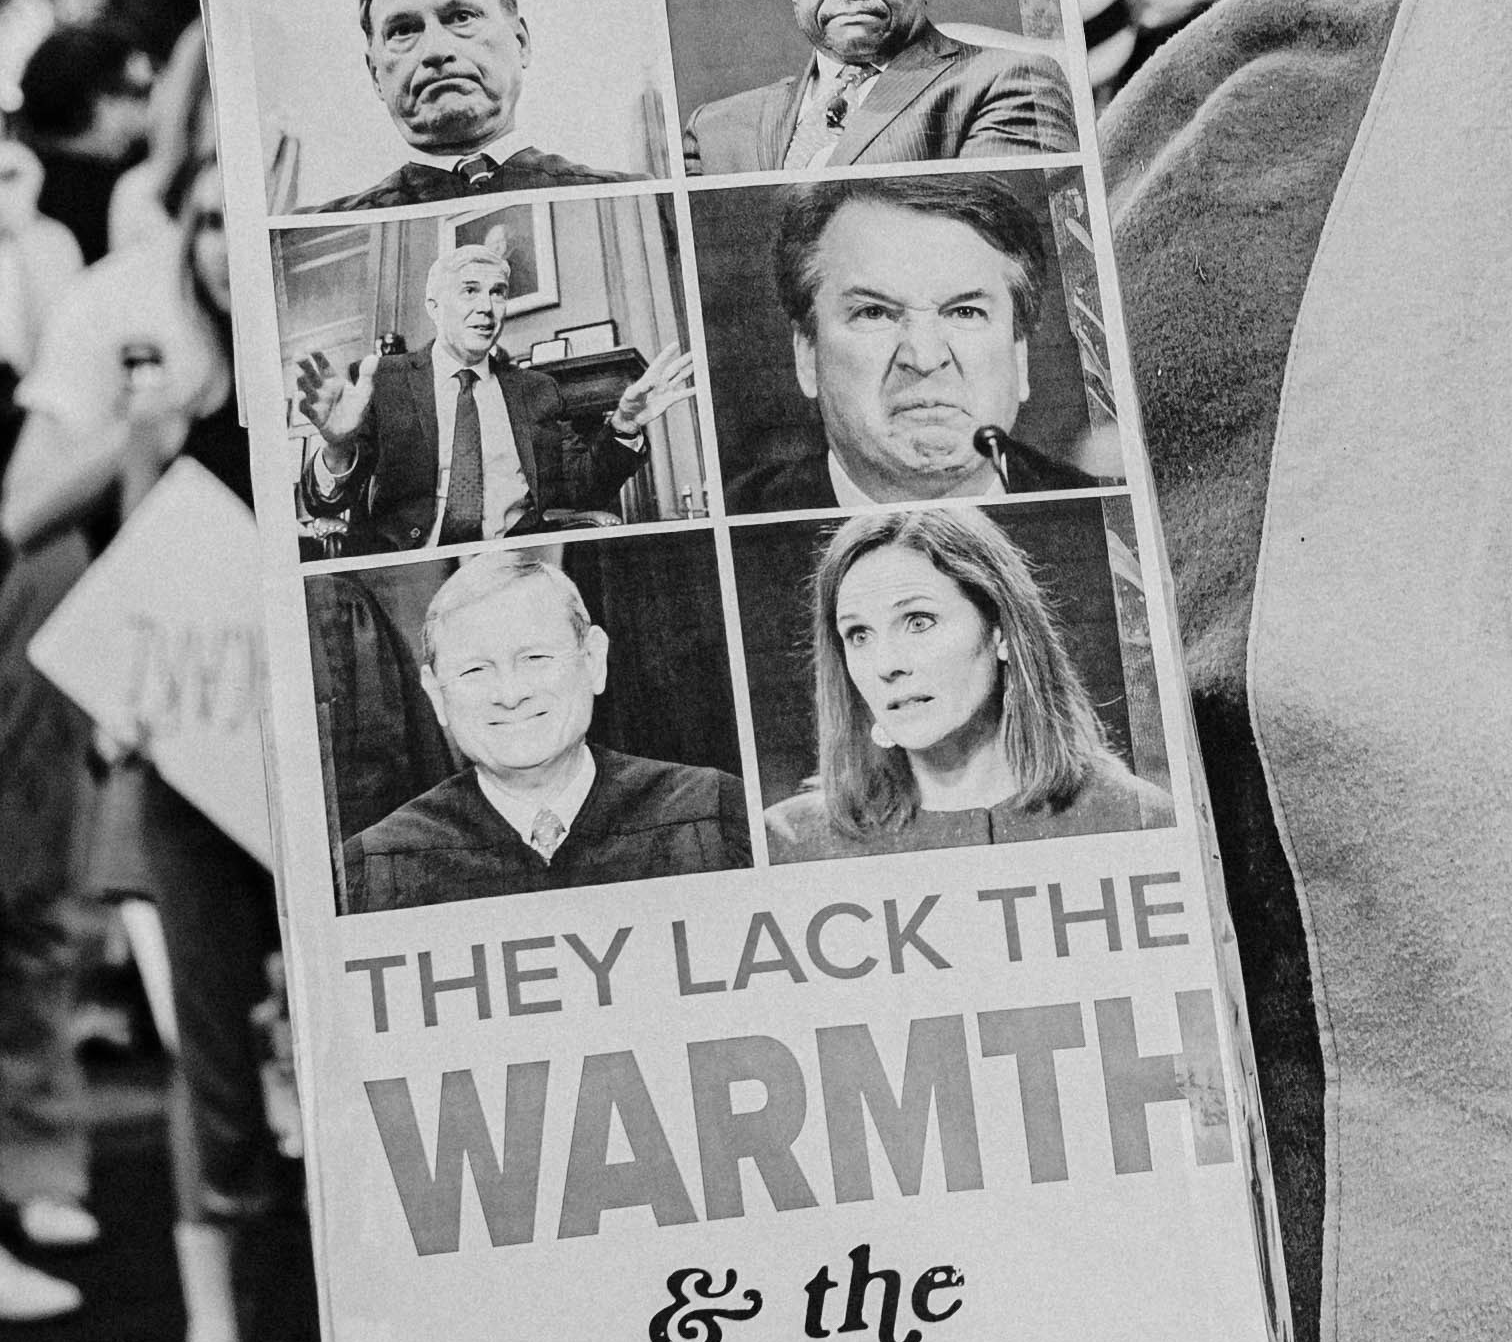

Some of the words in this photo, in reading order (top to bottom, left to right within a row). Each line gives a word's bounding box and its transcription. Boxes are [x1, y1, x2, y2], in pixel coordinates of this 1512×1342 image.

[345, 926, 632, 1033] THEY
[671, 895, 953, 997] LACK
[977, 871, 1190, 966] THE
[363, 987, 1234, 1256] WARMTH
